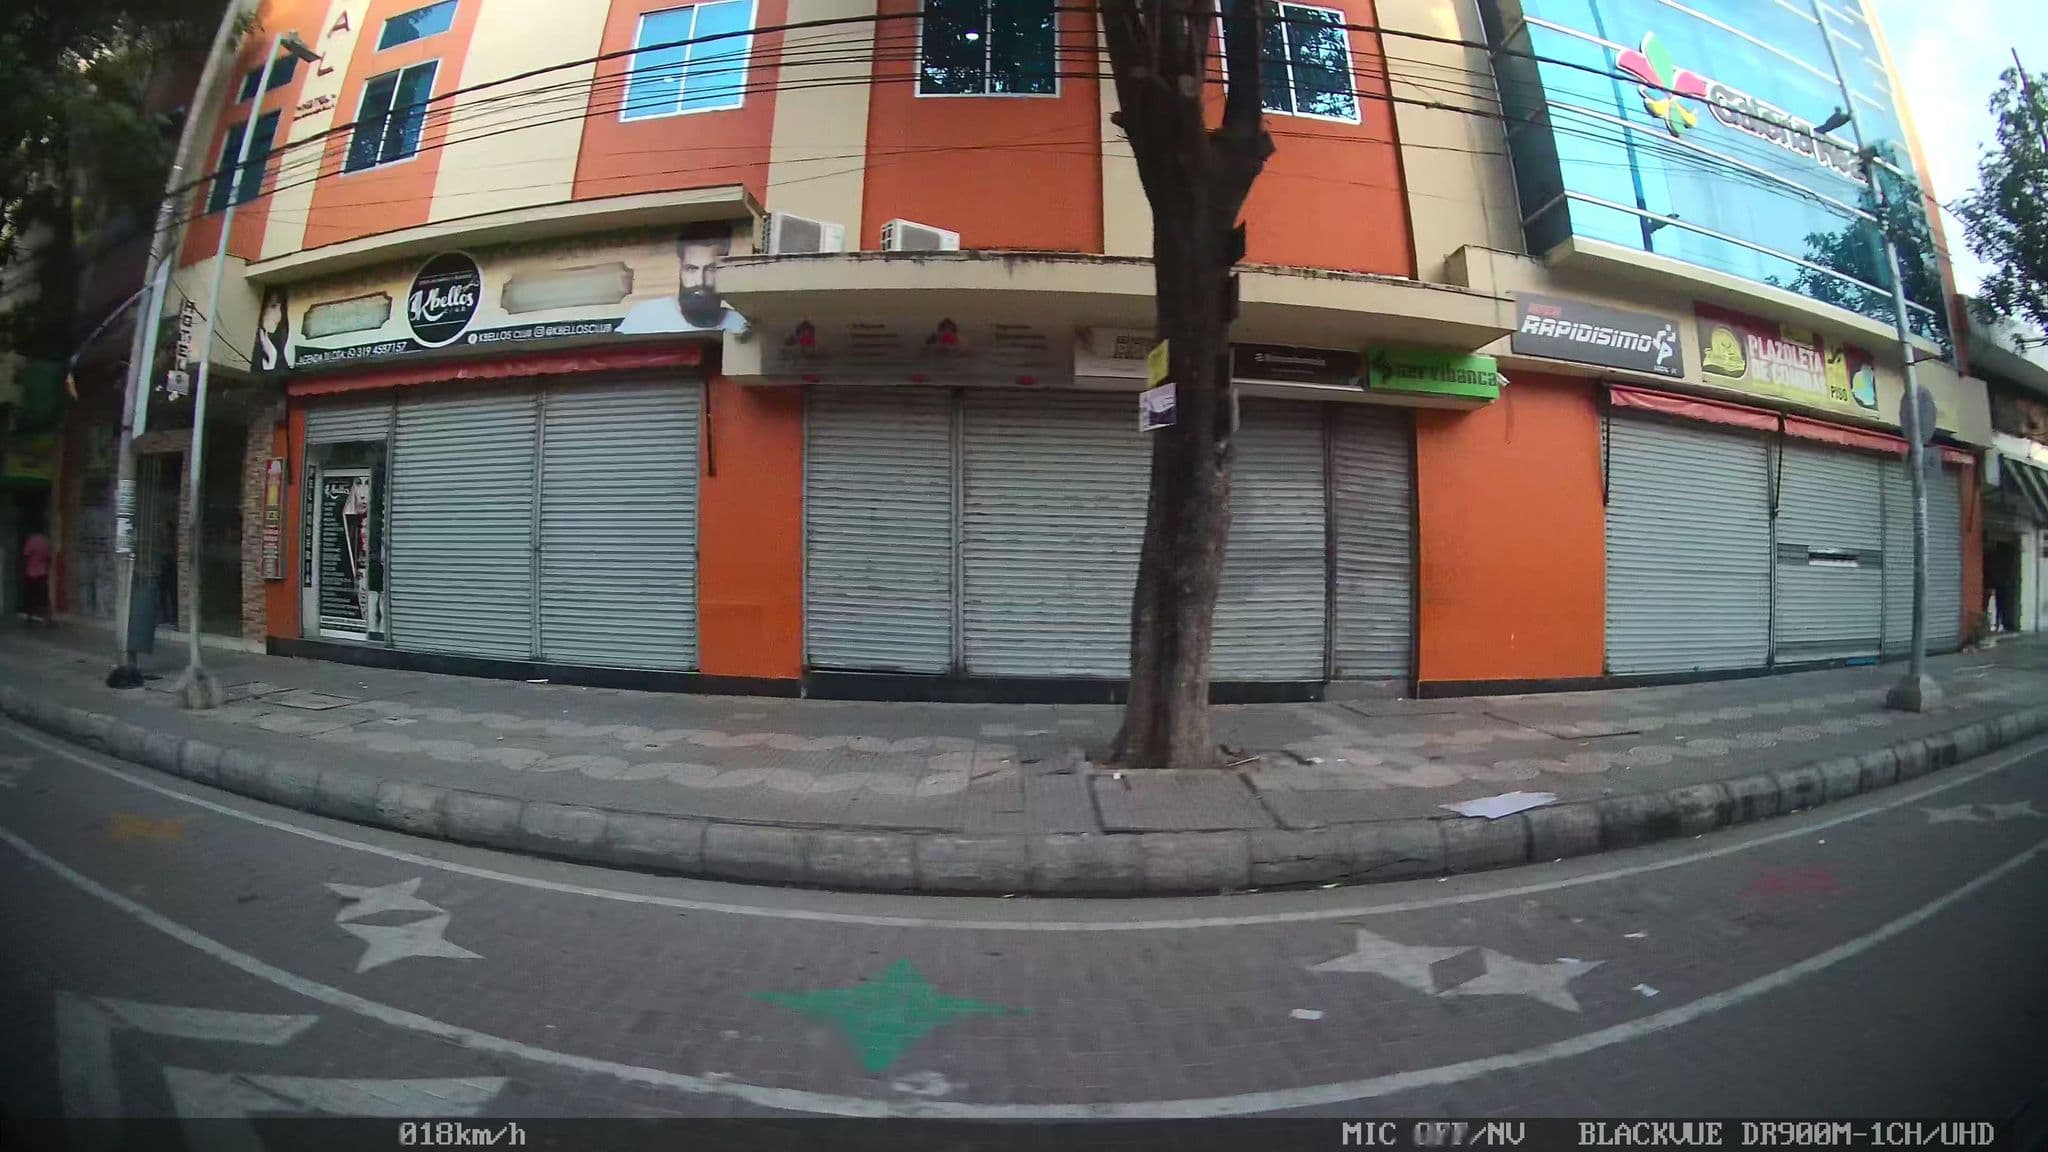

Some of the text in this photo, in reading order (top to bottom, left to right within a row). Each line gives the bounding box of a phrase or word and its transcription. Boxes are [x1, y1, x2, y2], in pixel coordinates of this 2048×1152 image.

[409, 284, 474, 321] Kbellos
[357, 346, 371, 356] 319
[1747, 334, 1826, 375] PLAZOLETA
